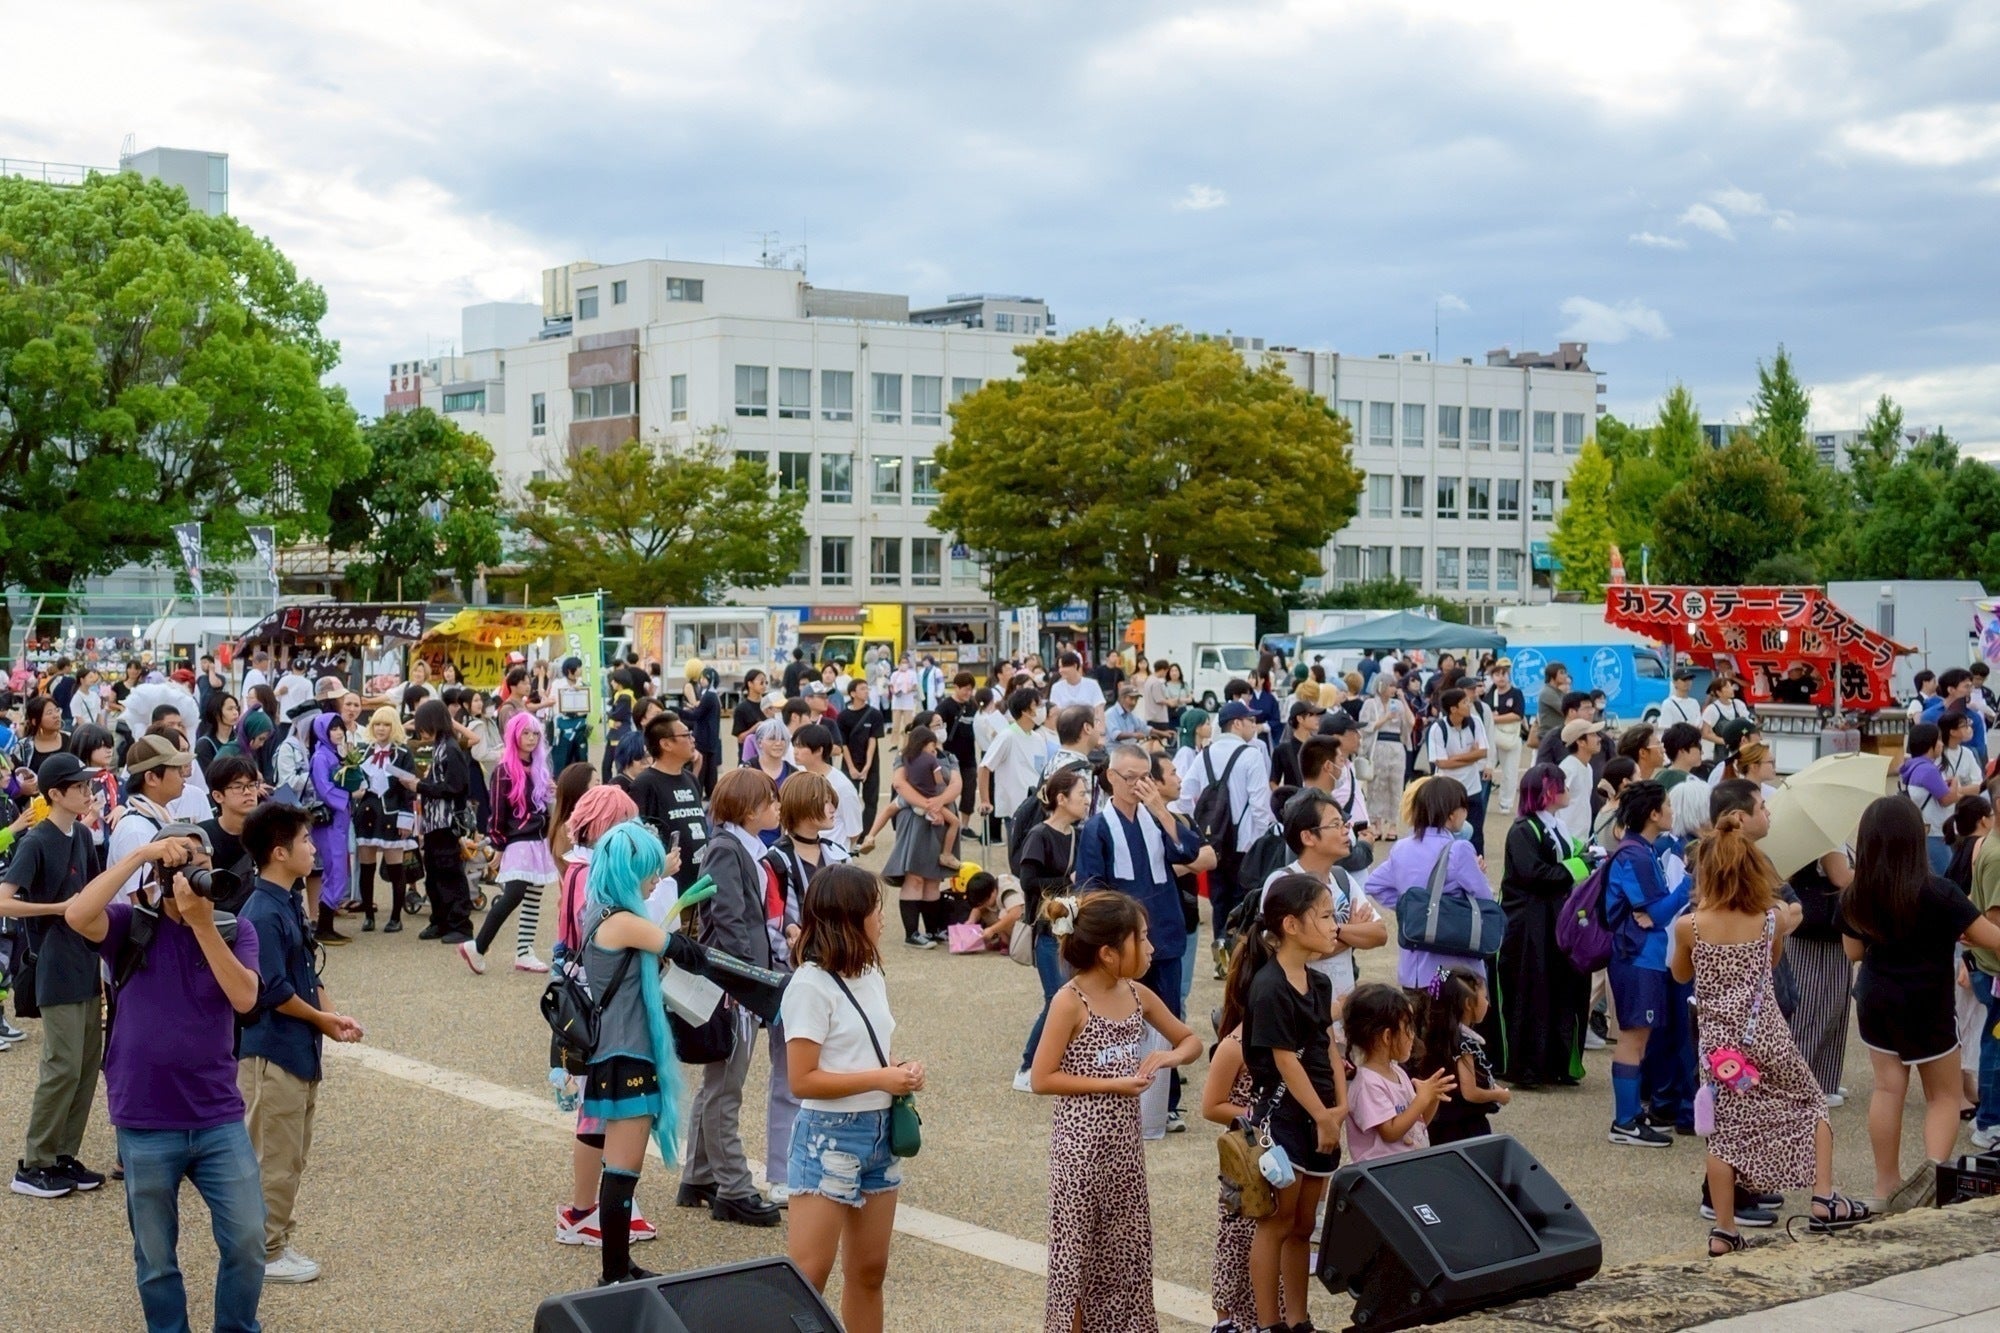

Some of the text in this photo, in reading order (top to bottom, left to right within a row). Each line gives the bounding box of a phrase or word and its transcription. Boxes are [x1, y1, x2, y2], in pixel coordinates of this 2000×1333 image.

[1811, 600, 1893, 667] カステーラ
